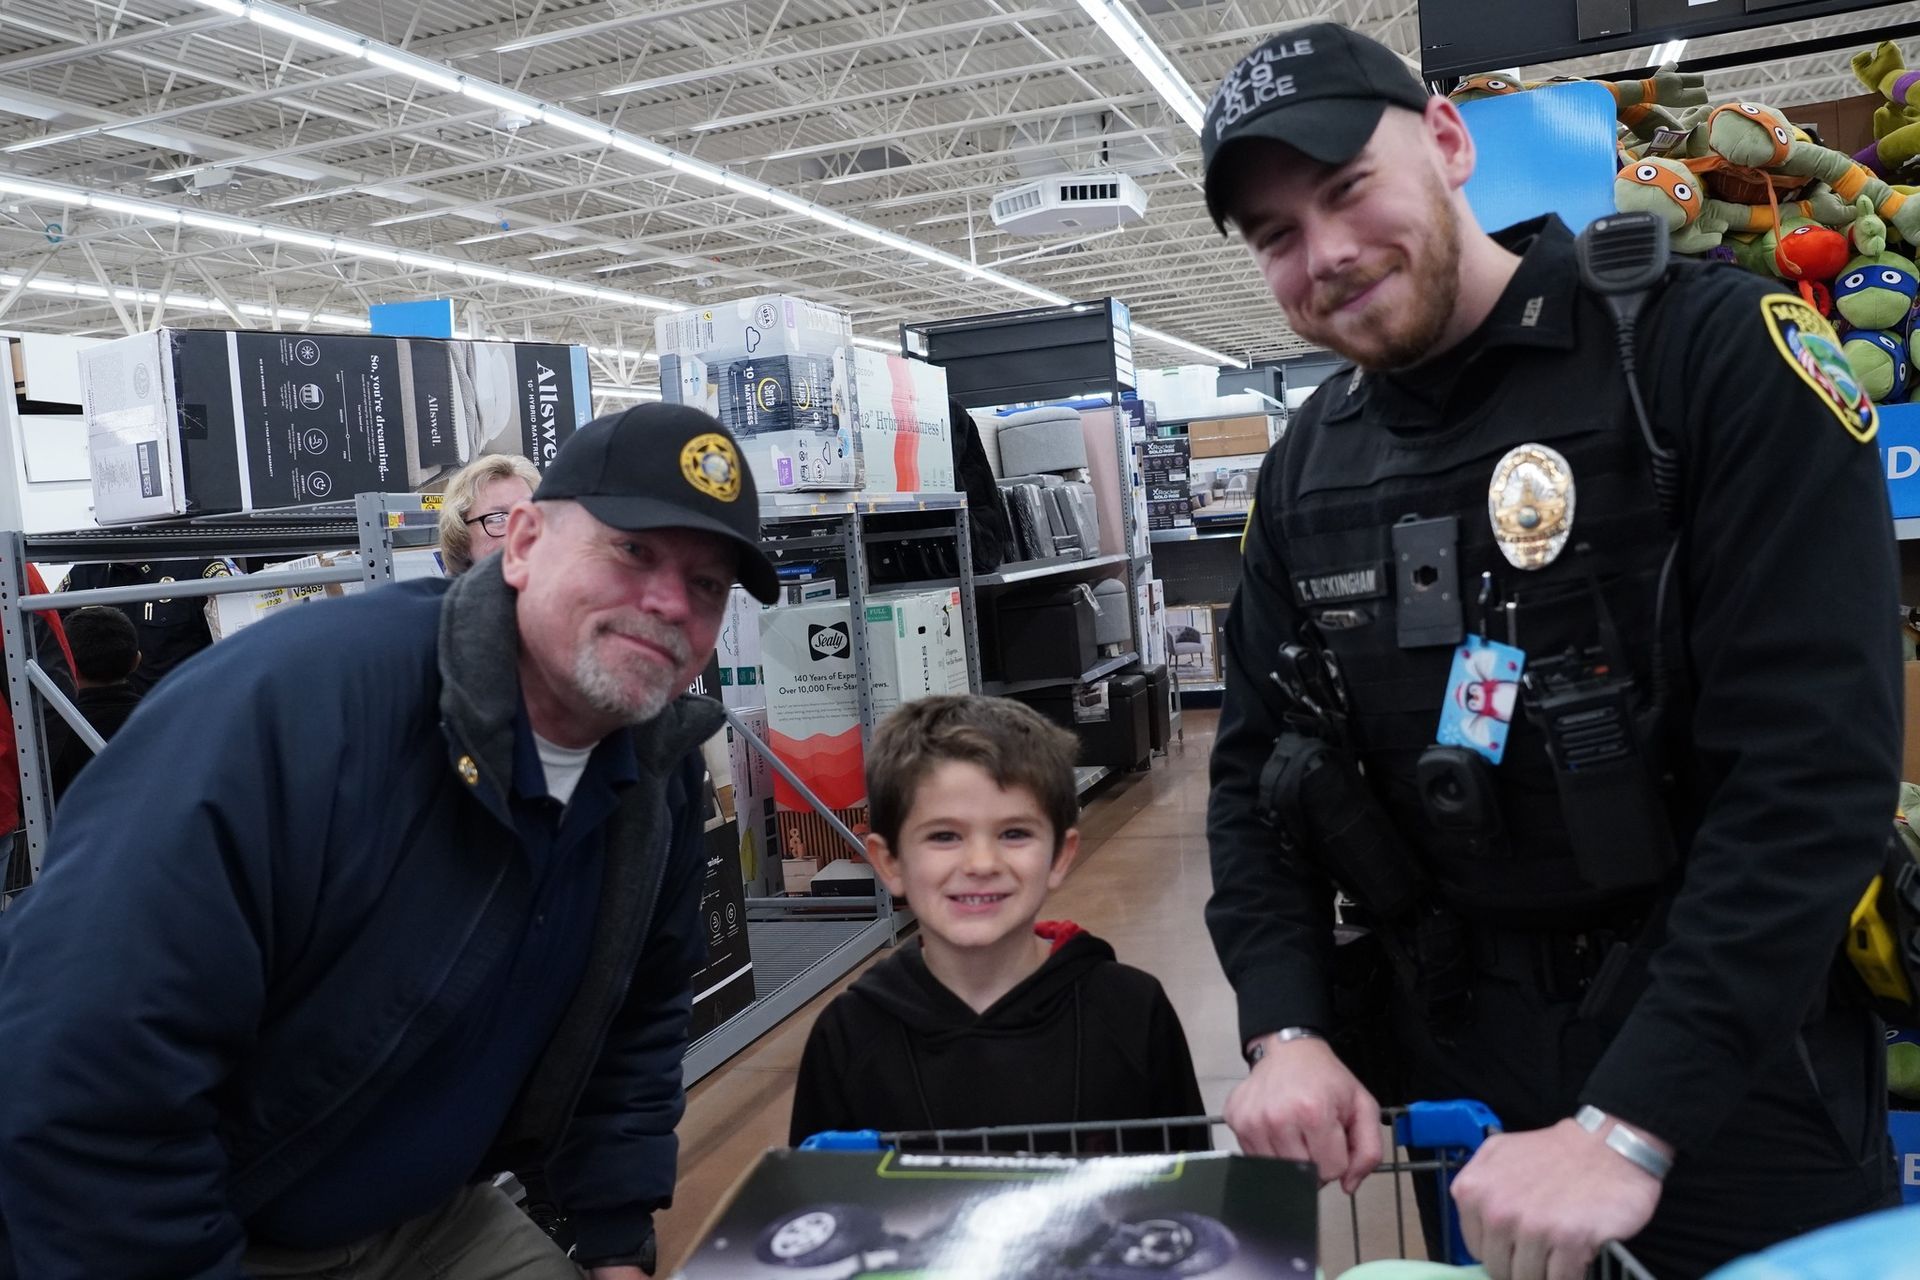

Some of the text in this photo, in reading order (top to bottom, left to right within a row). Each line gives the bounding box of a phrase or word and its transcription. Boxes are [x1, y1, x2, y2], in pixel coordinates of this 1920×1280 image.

[1215, 74, 1297, 141] POLICE
[746, 366, 754, 379] 10
[528, 394, 536, 423] HYBRID
[744, 383, 754, 425] MATTRESS
[764, 384, 777, 406] Serta
[369, 354, 390, 482] So, you're dreaming...
[427, 394, 441, 447] Allswell.
[860, 410, 940, 437] 12" Hybrid Mattress
[530, 424, 539, 467] MATTRESS
[293, 584, 324, 598] V5469
[814, 632, 844, 649] Sealy
[778, 686, 797, 696] Over
[798, 684, 825, 696] 10,000
[826, 682, 857, 693] Five-Star
[794, 671, 857, 684] 140 Years of Exper
